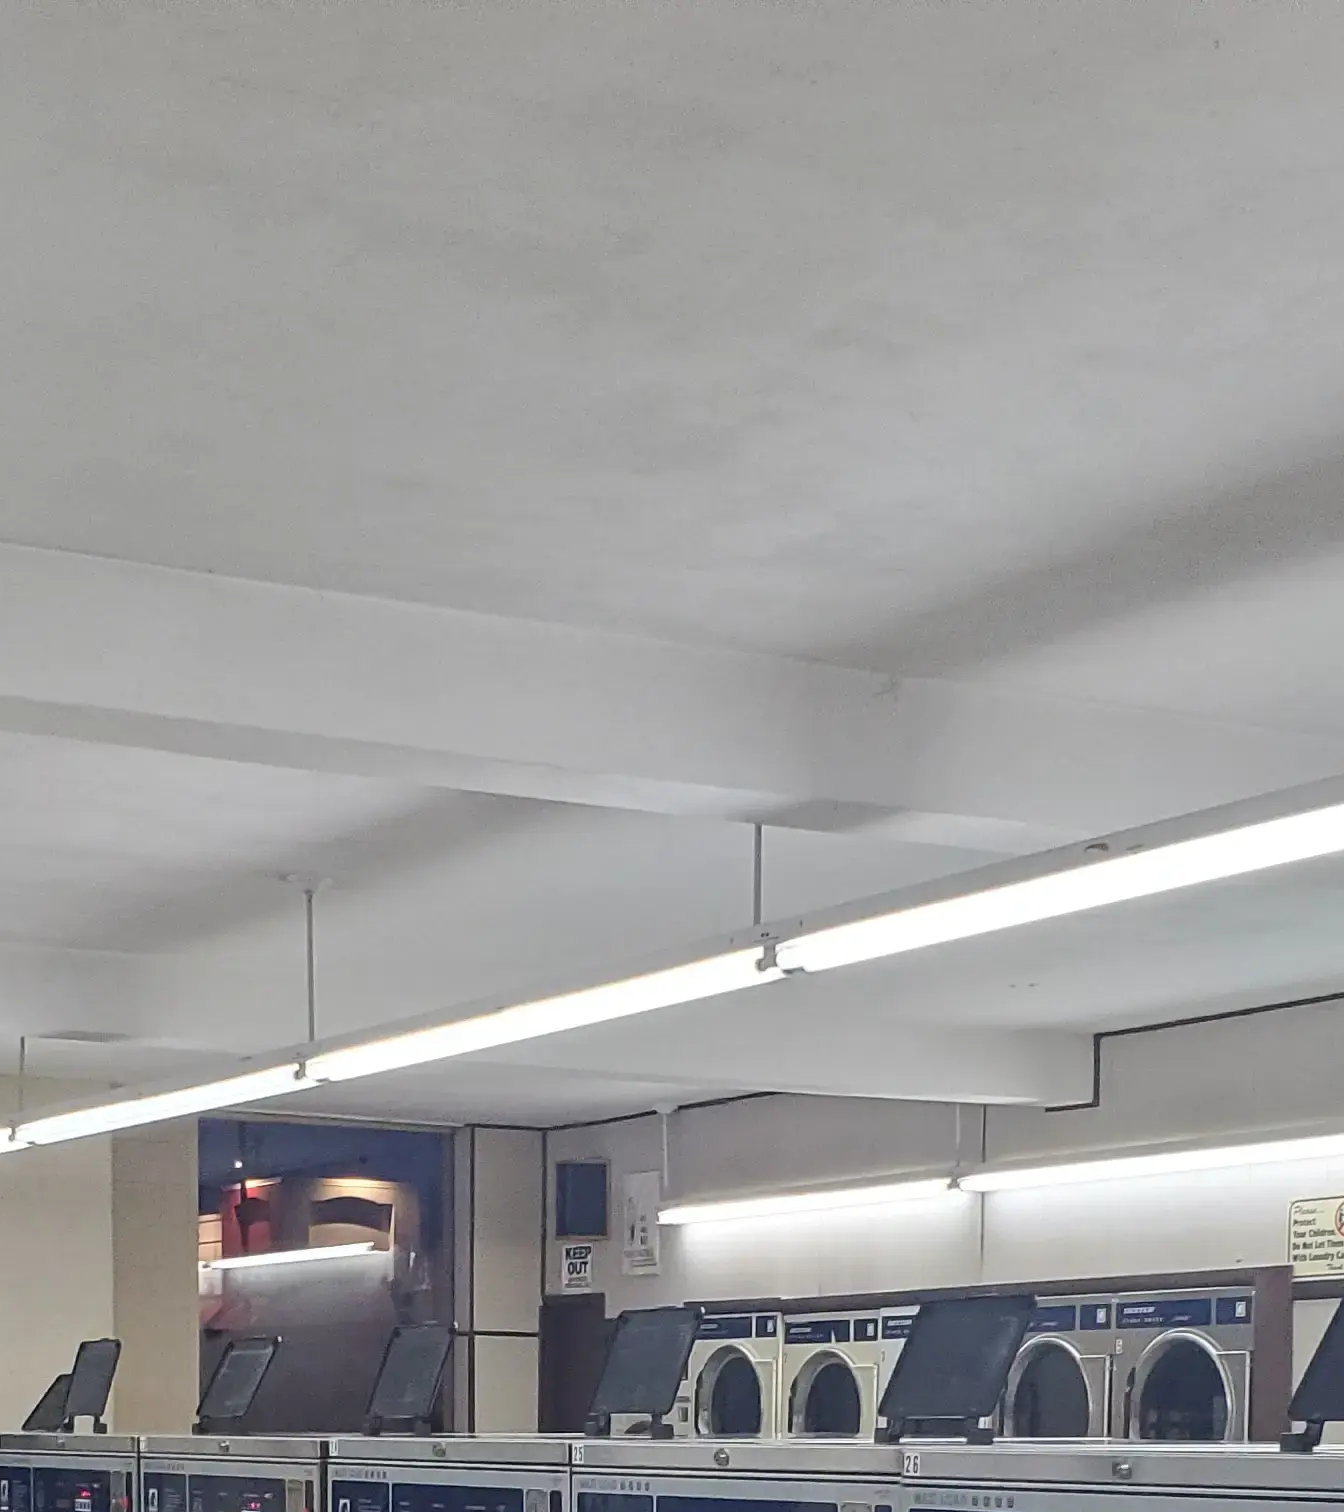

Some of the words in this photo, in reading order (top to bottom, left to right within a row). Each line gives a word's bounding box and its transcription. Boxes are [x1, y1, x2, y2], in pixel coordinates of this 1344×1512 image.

[565, 1246, 592, 1260] KEEP
[568, 1261, 588, 1276] OUT
[574, 1446, 583, 1462] 25
[905, 1456, 919, 1474] 26
